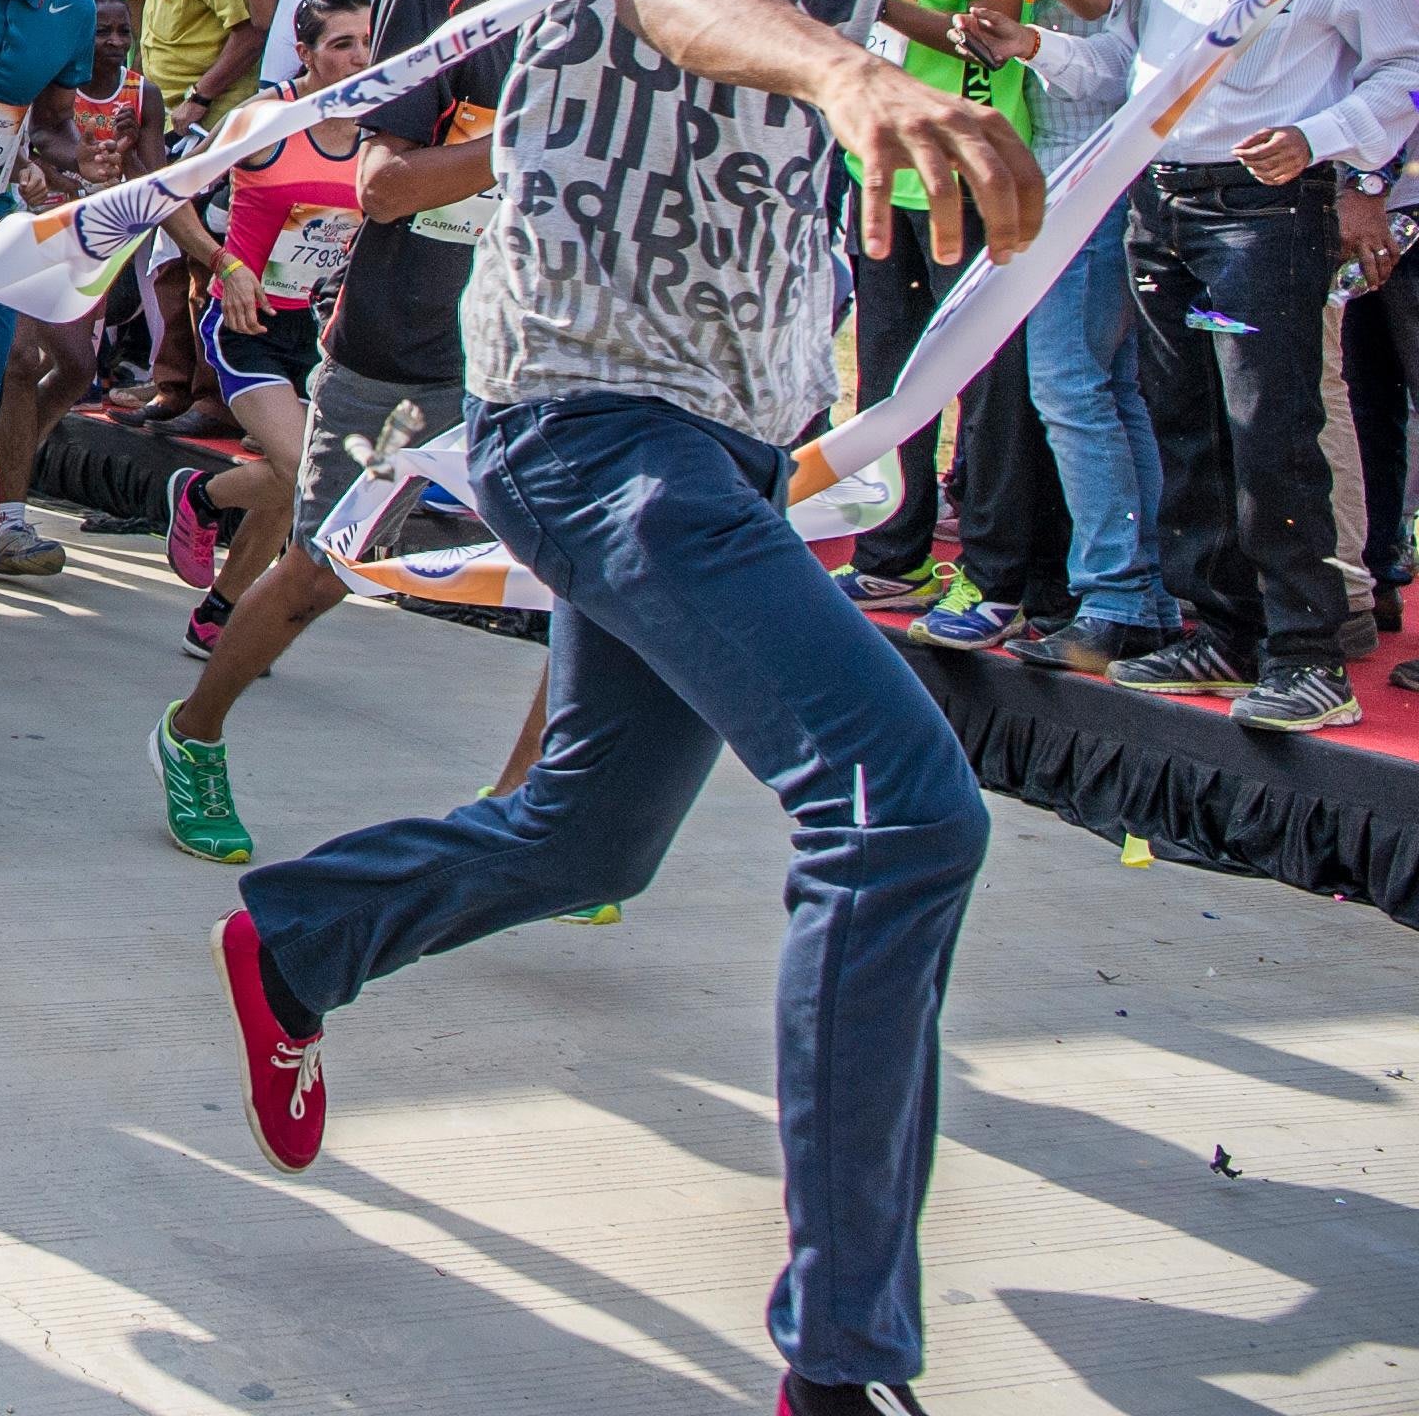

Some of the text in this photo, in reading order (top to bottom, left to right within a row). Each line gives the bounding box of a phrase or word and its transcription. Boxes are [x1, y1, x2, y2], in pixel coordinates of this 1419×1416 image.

[407, 17, 503, 68] FOR LIFE
[421, 217, 471, 234] GARMIN
